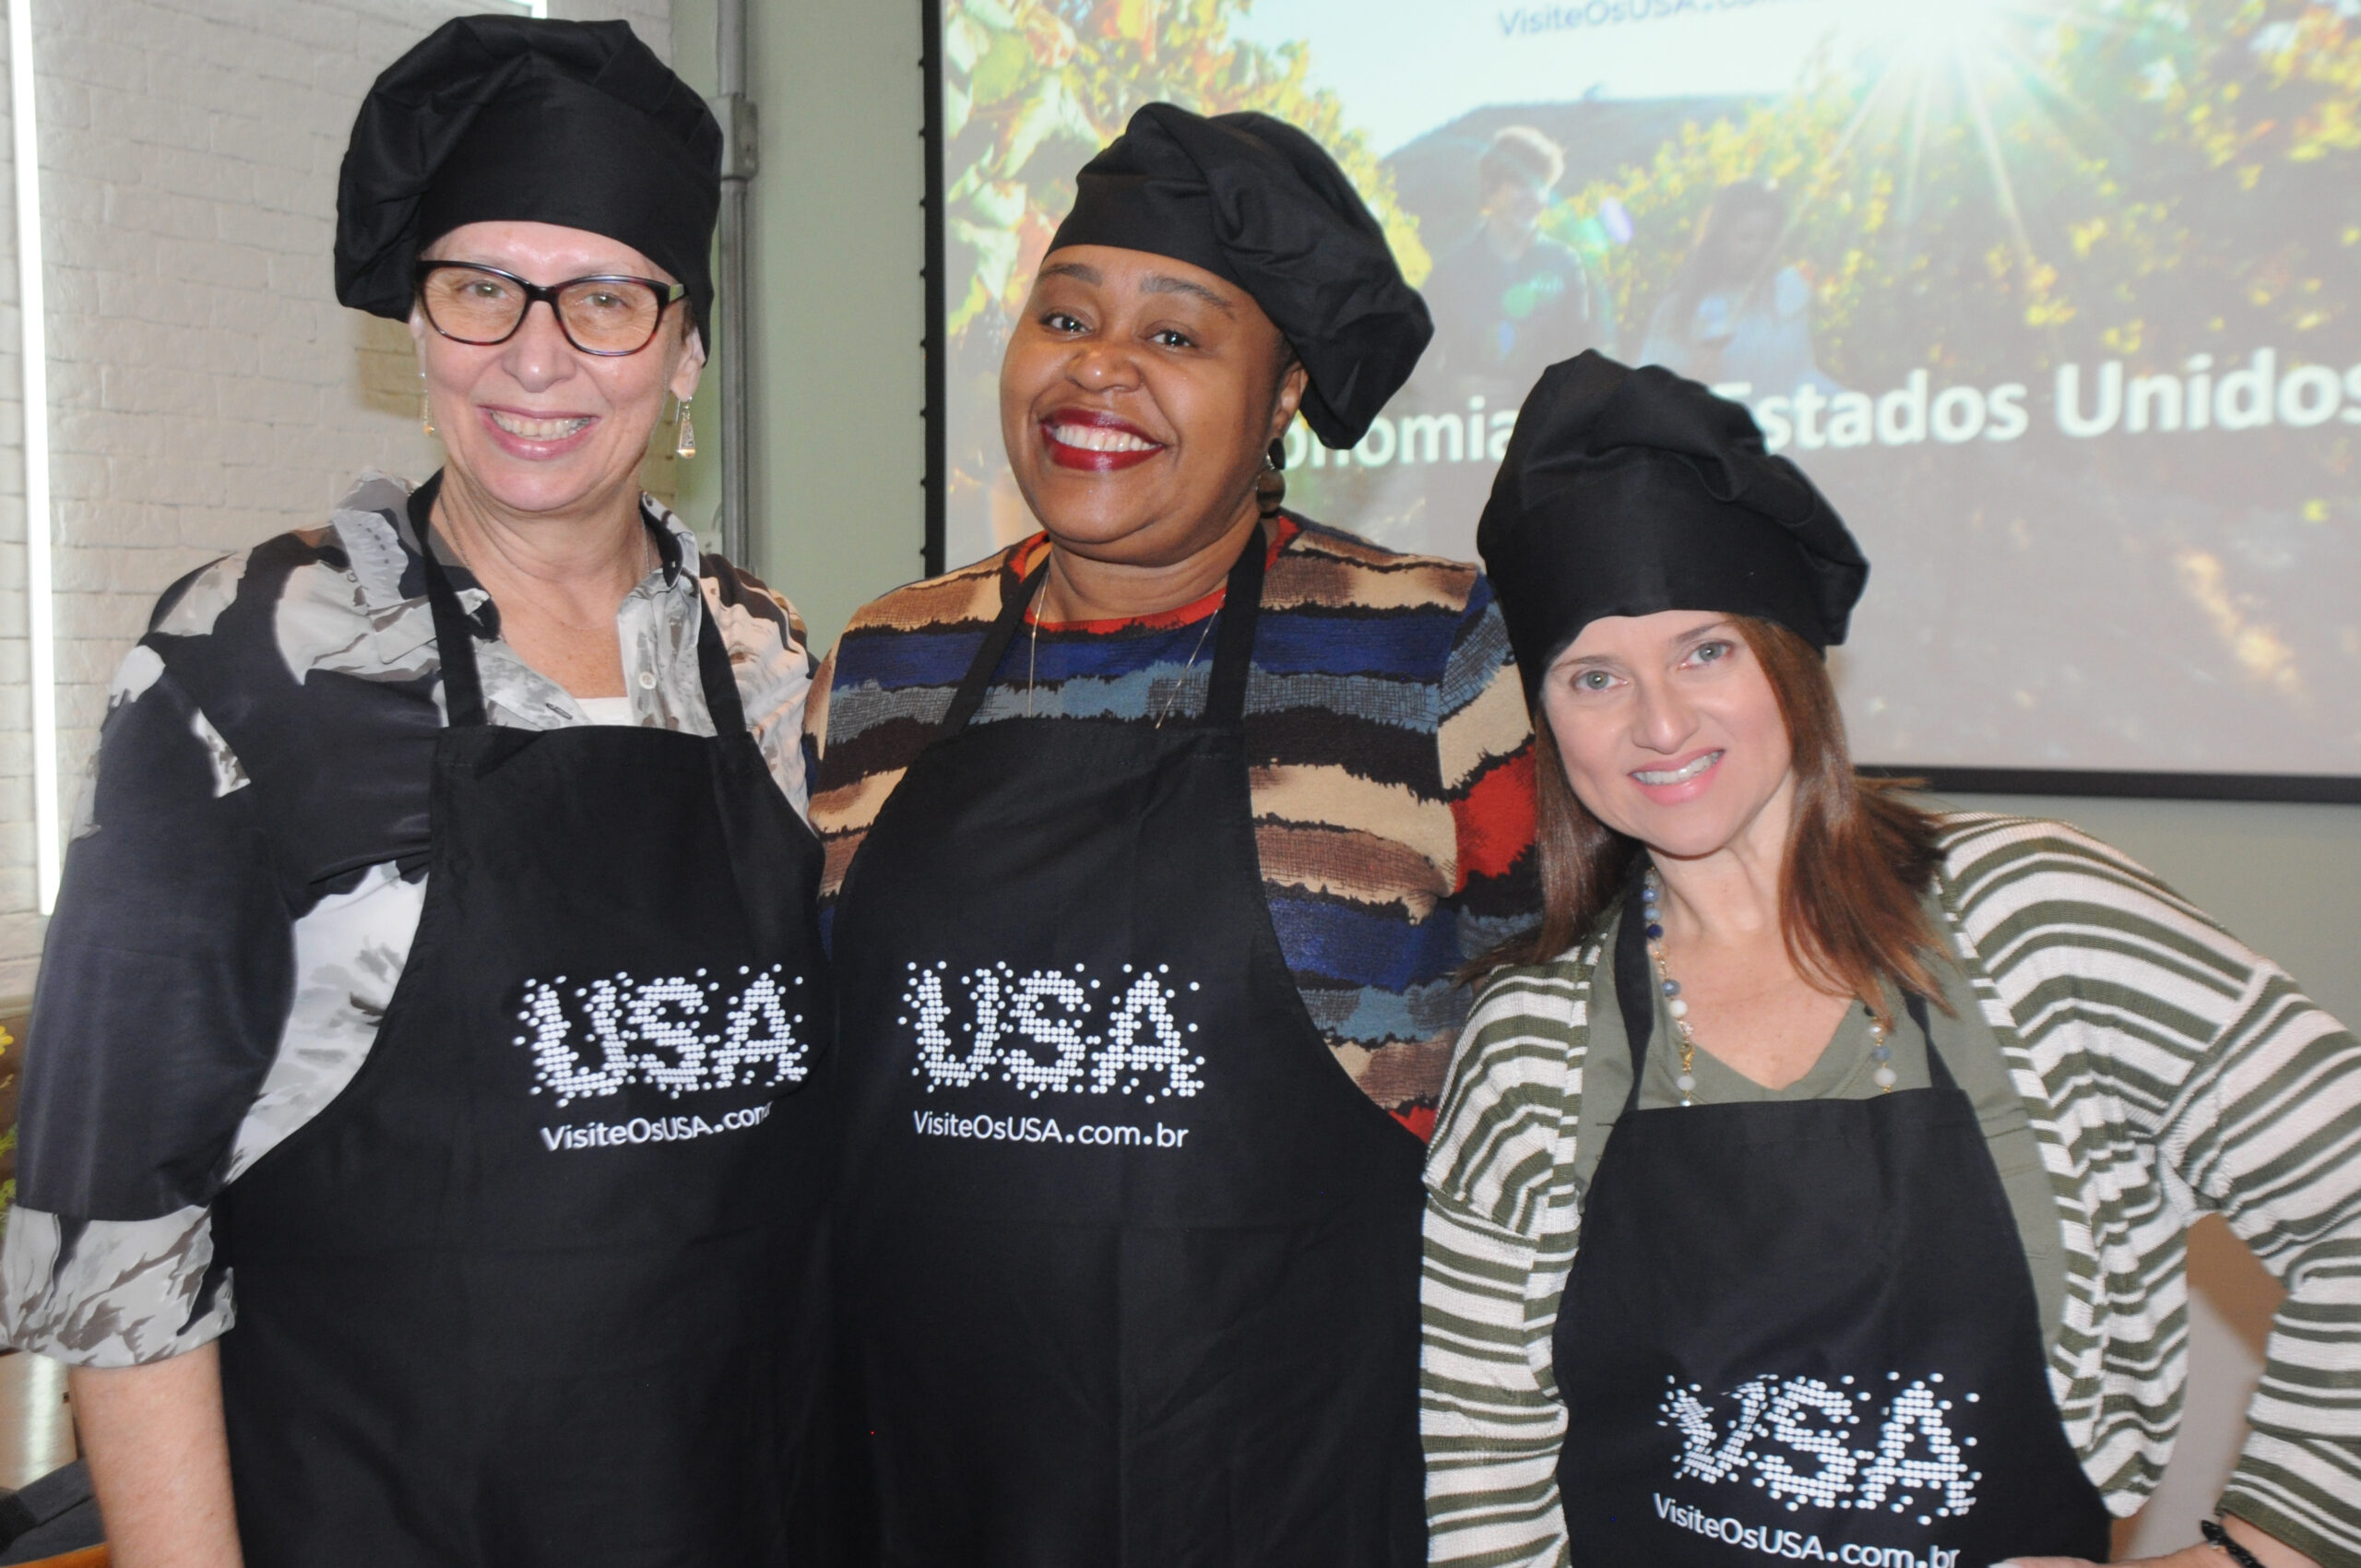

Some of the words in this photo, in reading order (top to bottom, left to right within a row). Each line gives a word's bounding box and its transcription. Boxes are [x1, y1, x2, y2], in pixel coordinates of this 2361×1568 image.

[1709, 368, 2029, 452] stados
[513, 963, 808, 1108] USA
[897, 960, 1205, 1103] USA
[913, 1111, 1190, 1147] VisiteOsUSA.com.br
[1657, 1371, 1982, 1525] USA
[1653, 1492, 1962, 1568] VisiteOsUSA.com.br
